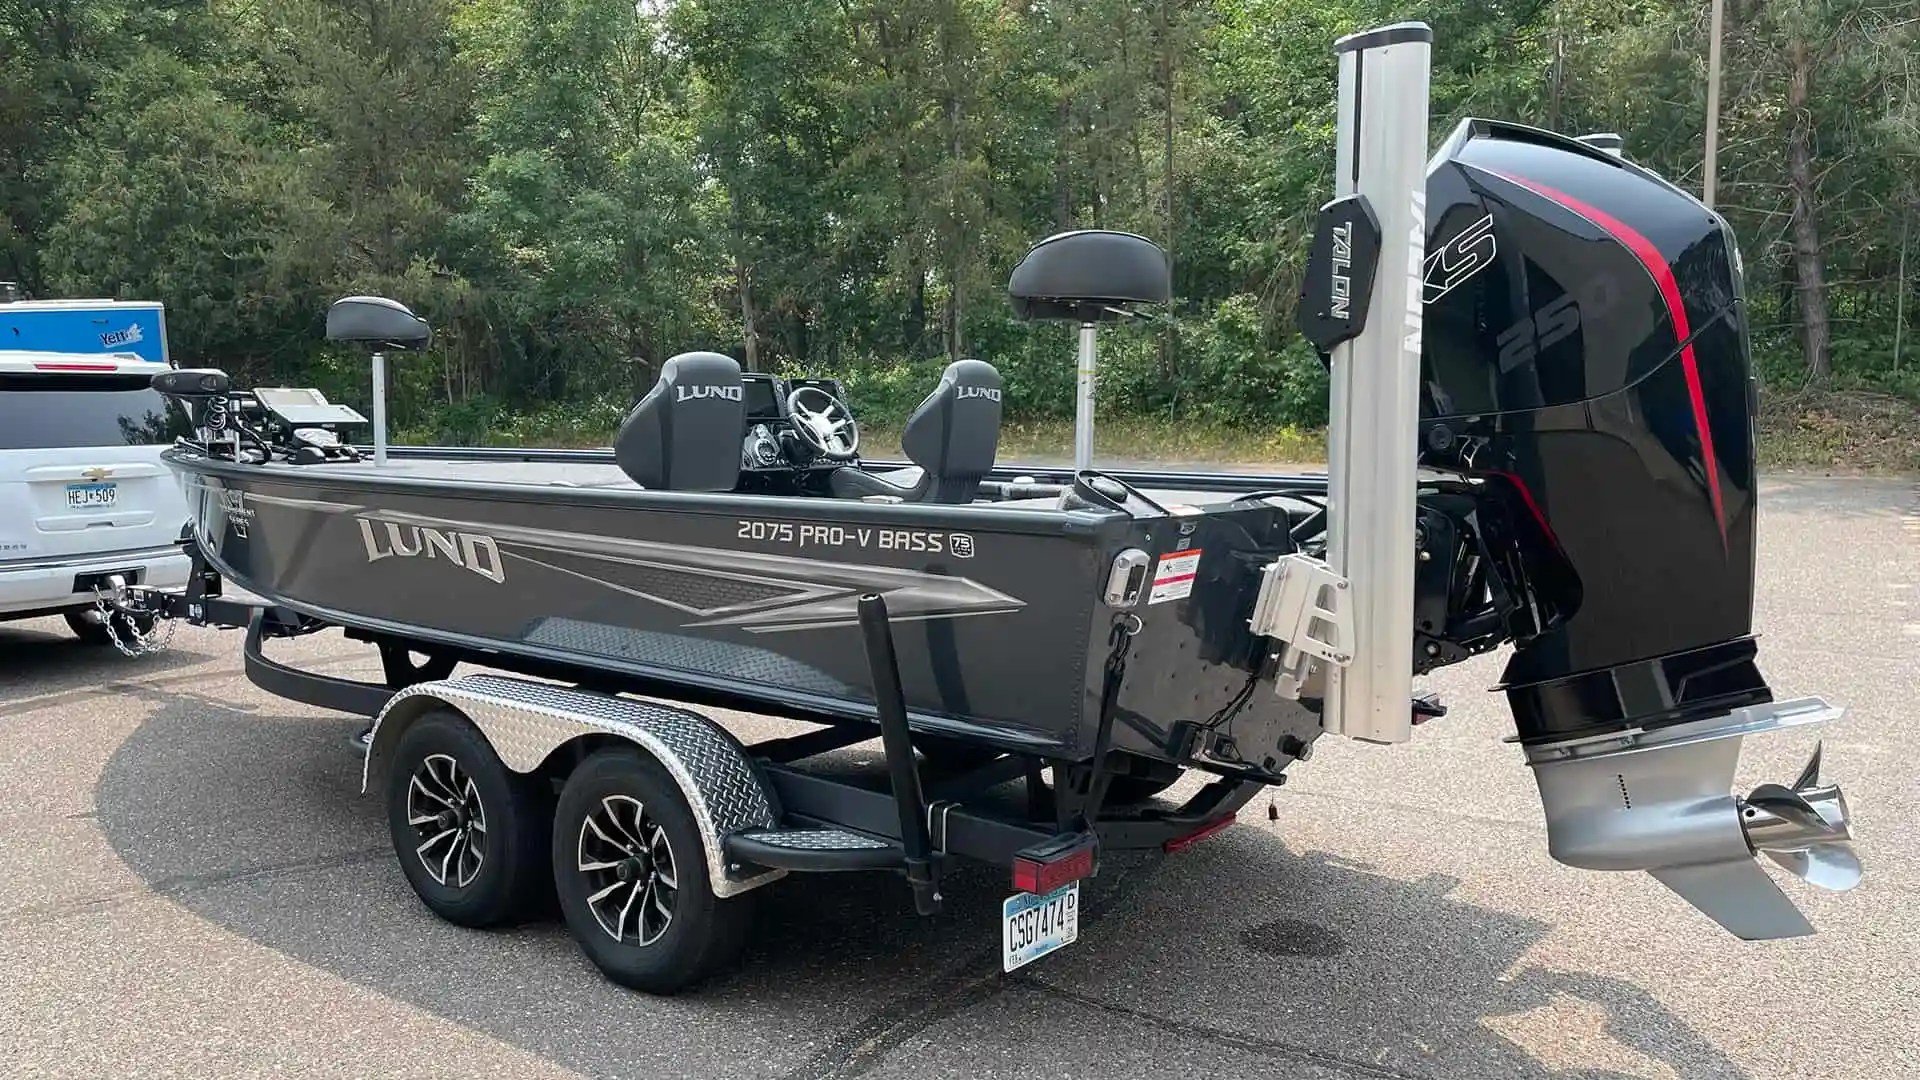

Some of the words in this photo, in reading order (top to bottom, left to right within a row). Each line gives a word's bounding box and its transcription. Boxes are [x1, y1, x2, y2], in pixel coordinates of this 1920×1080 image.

[1330, 221, 1352, 320] TALON
[676, 385, 742, 402] LUND
[957, 386, 1001, 402] LUND
[68, 490, 89, 505] HEJ
[95, 488, 115, 503] 509
[738, 521, 793, 542] 2075
[800, 525, 871, 548] PRO-V
[879, 530, 943, 553] BASS
[952, 537, 970, 548] 75
[356, 518, 506, 584] LUND
[1009, 896, 1065, 953] CSG7474
